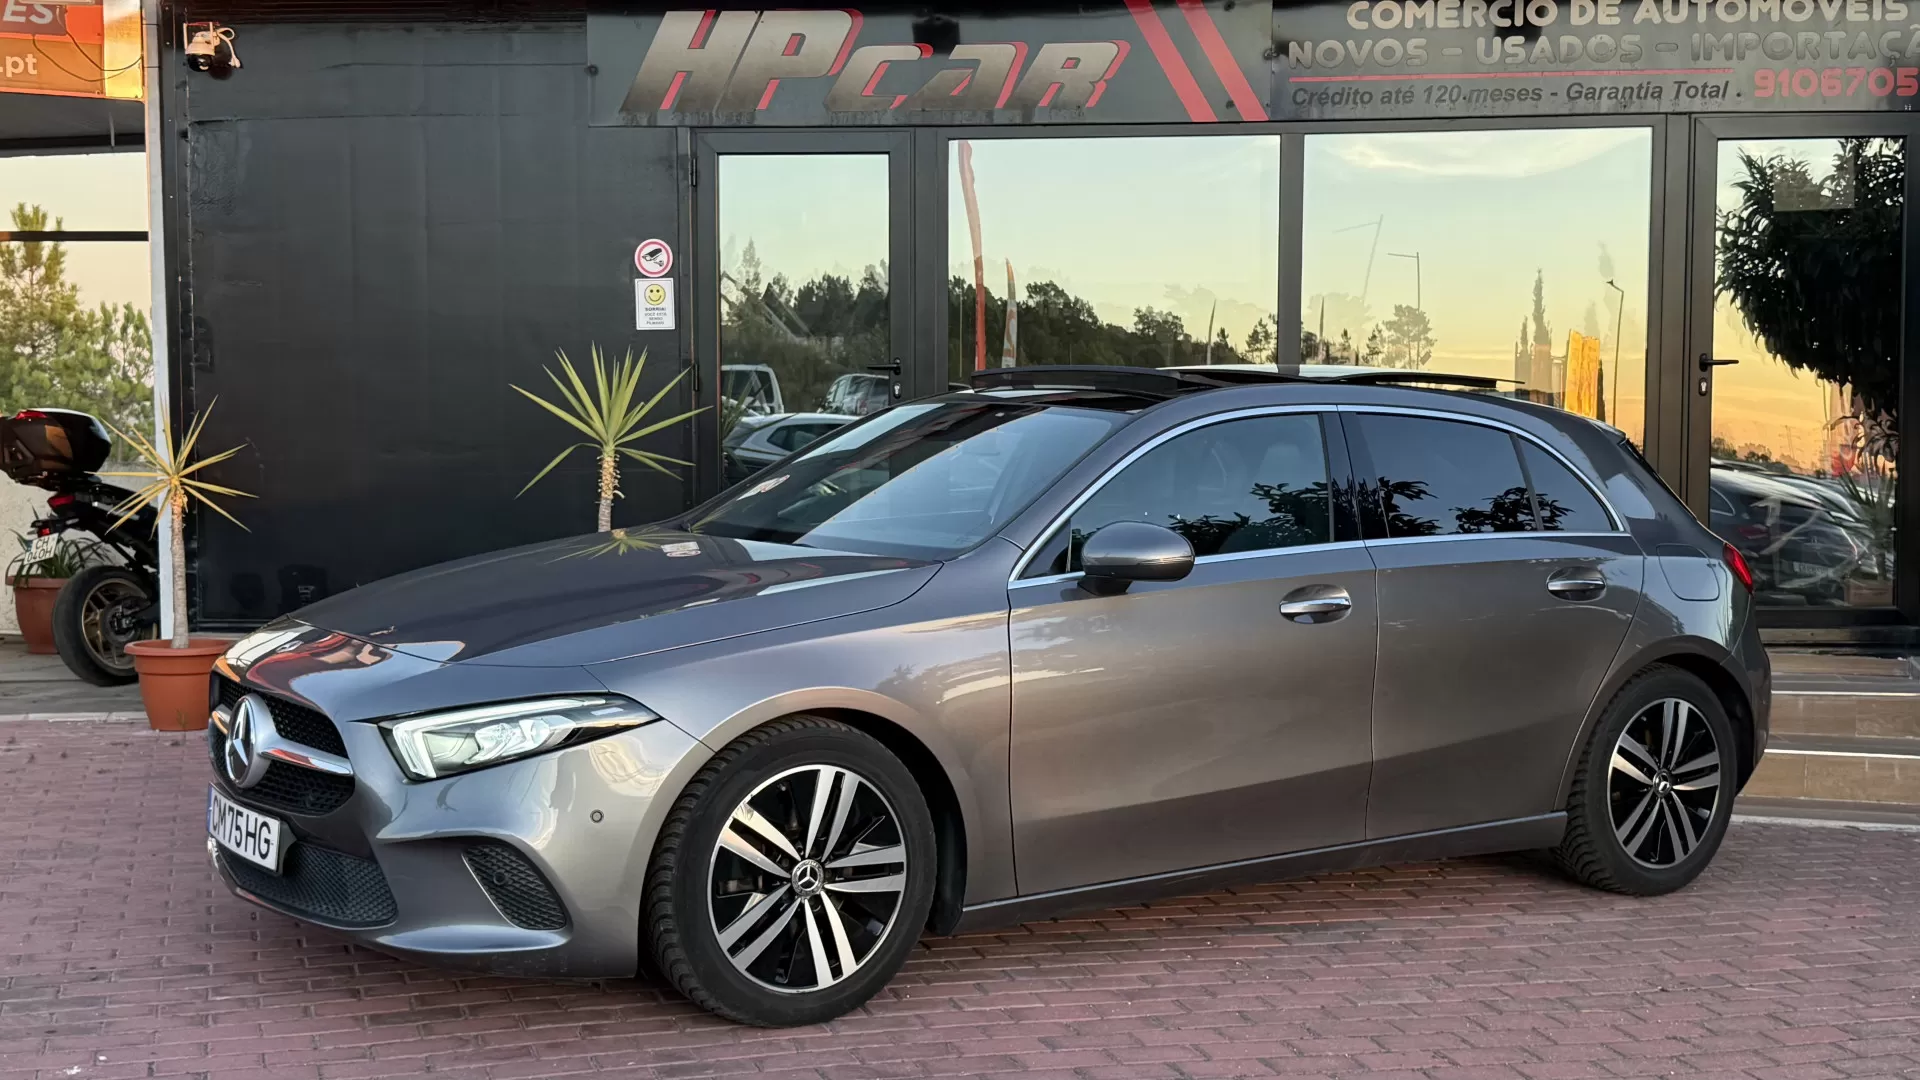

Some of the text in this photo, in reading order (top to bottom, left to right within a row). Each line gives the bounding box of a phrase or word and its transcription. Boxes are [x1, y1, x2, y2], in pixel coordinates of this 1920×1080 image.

[1570, 0, 1620, 26] DE
[1288, 37, 1429, 69] NOVOS
[1476, 34, 1643, 65] USADOS
[1291, 86, 1374, 106] Crédito
[1379, 85, 1415, 105] até
[1423, 85, 1462, 104] 120
[1468, 87, 1543, 103] meses
[1565, 81, 1663, 102] Garantia
[1672, 80, 1729, 100] Total
[1754, 67, 1919, 97] 9106705
